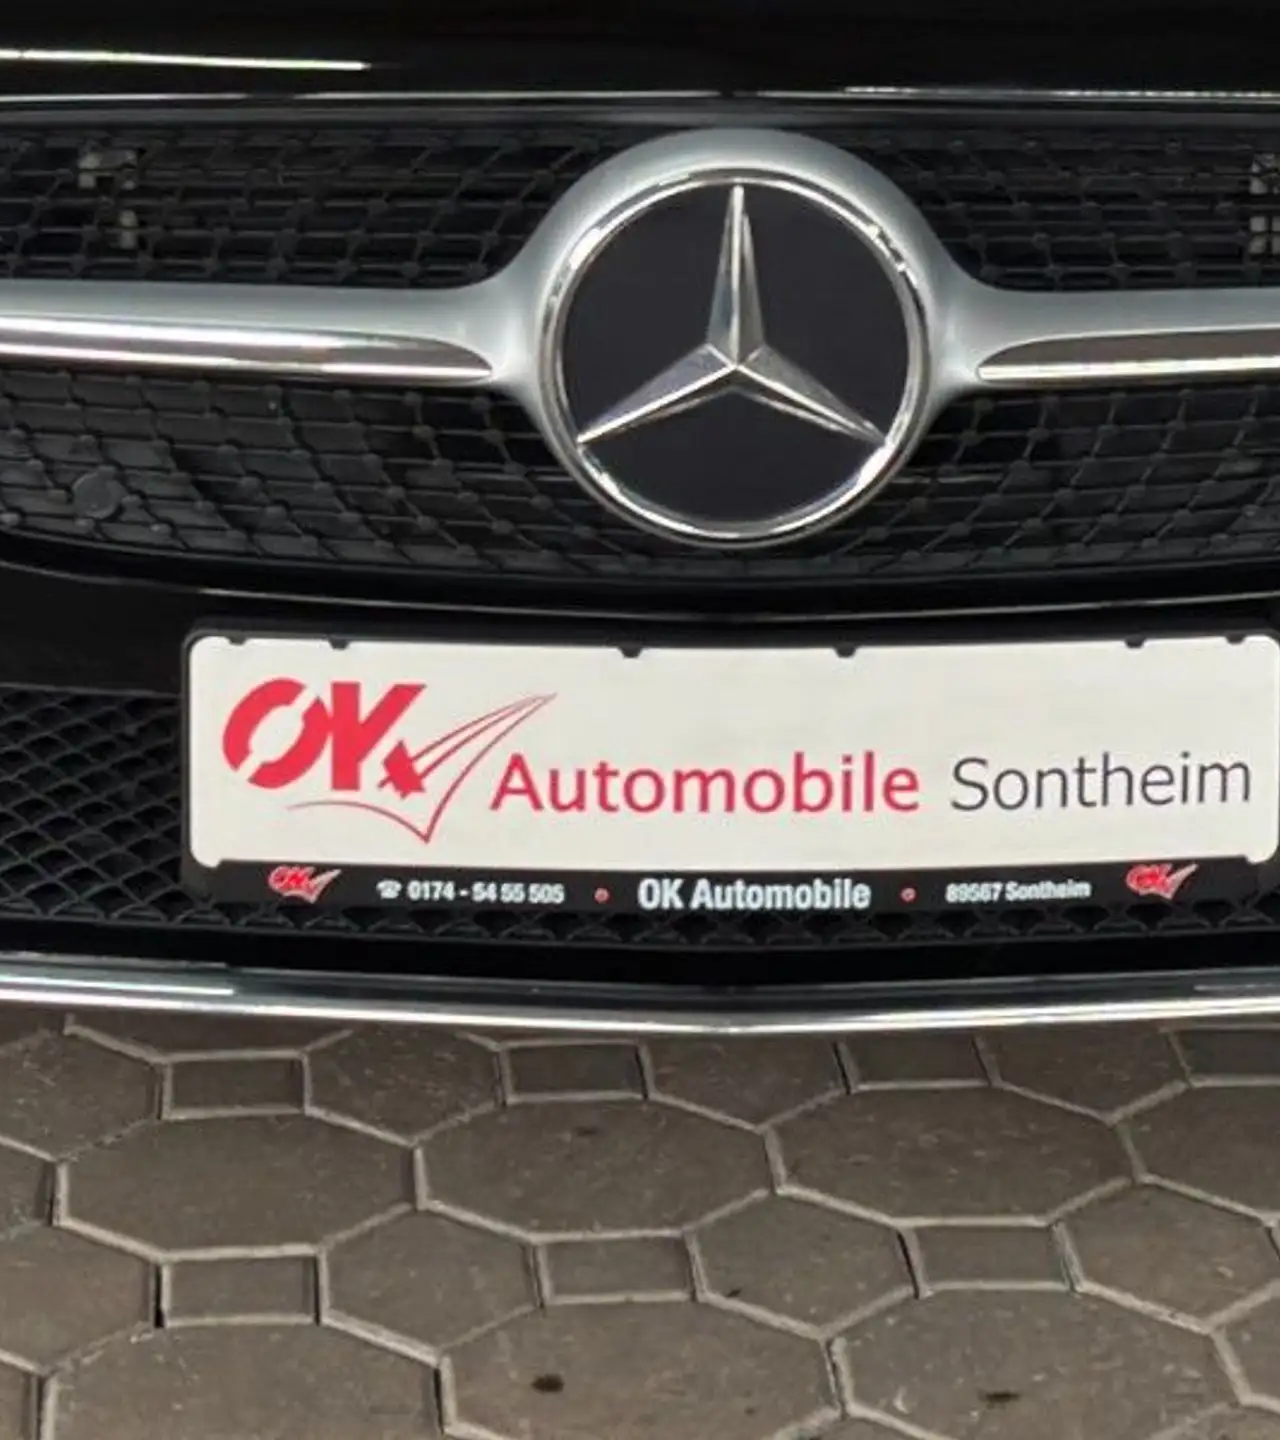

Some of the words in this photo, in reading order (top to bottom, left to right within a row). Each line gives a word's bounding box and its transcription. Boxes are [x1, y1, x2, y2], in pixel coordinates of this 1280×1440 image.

[222, 676, 427, 800] OK
[488, 752, 920, 814] Automobile
[950, 752, 1252, 812] Sontheim
[406, 879, 456, 901] 0174
[637, 877, 685, 910] OK
[690, 877, 872, 910] Automobile
[1005, 879, 1092, 901] Sontheim
